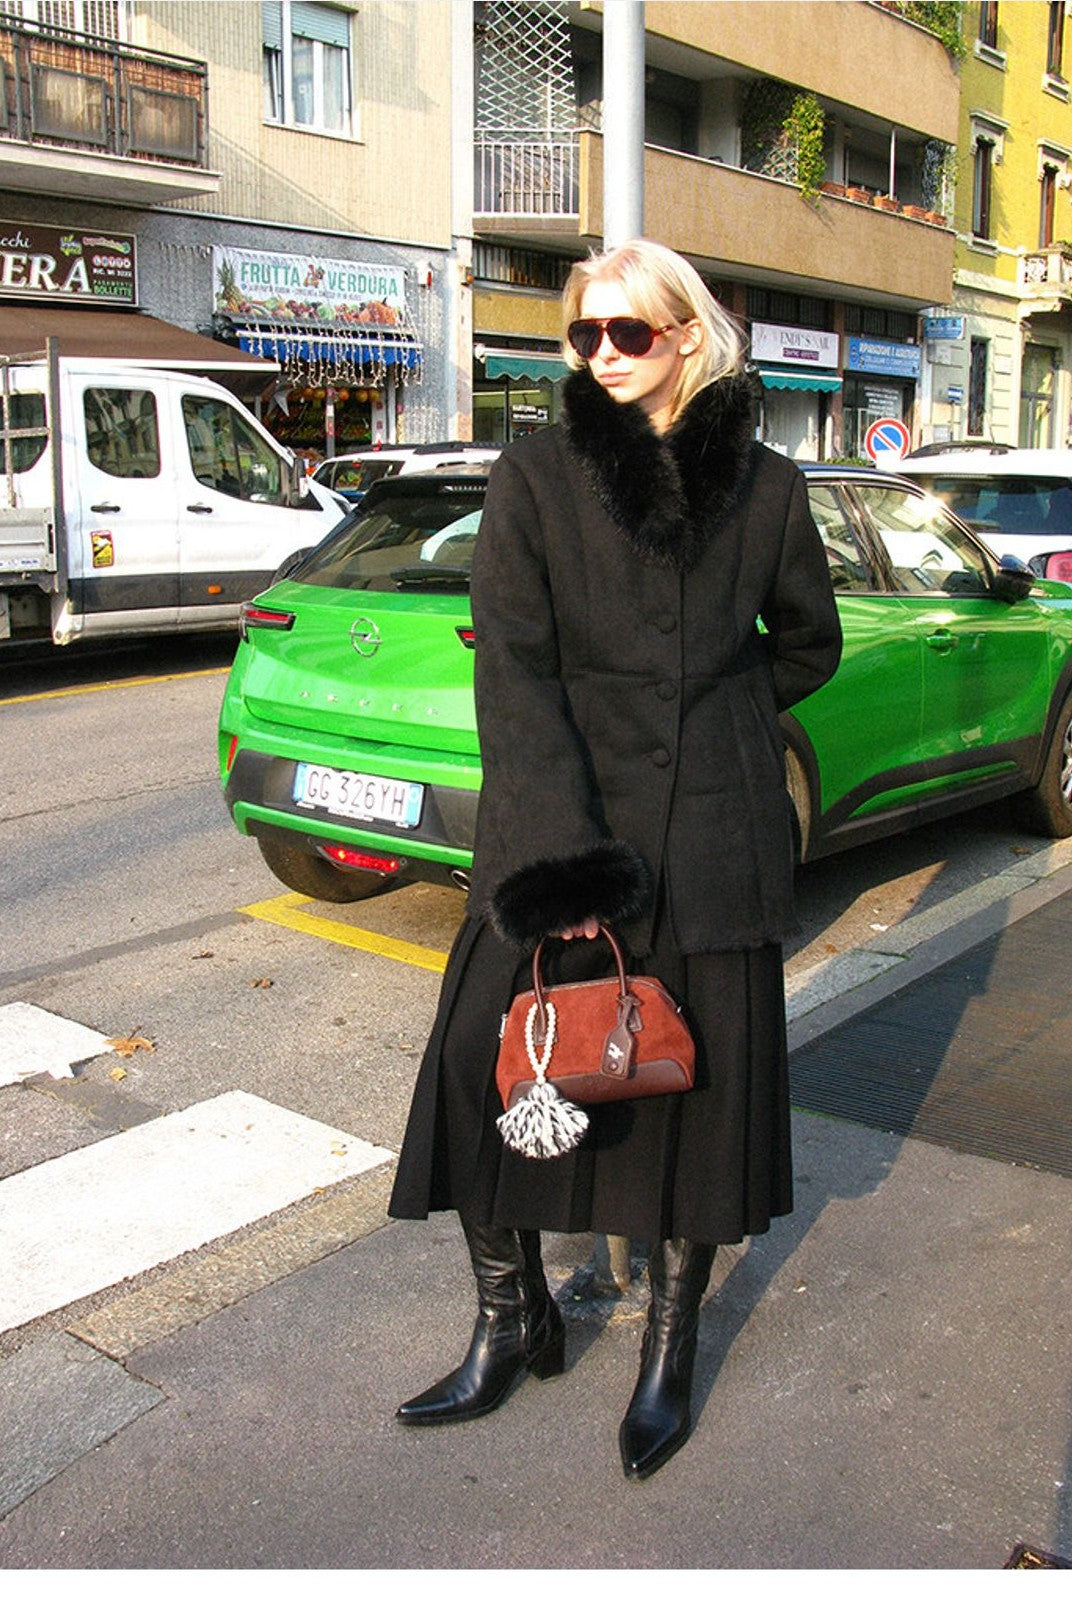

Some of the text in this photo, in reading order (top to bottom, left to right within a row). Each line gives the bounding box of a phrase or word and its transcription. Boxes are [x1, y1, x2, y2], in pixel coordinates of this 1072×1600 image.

[0, 231, 30, 248] cchi
[0, 251, 91, 293] ERA
[92, 254, 131, 269] LOTTO
[94, 286, 132, 297] BOLLETTE
[241, 261, 301, 287] FRUTTA
[327, 271, 398, 297] VERDURA
[308, 771, 332, 801] GG
[338, 775, 406, 816] 326YH
